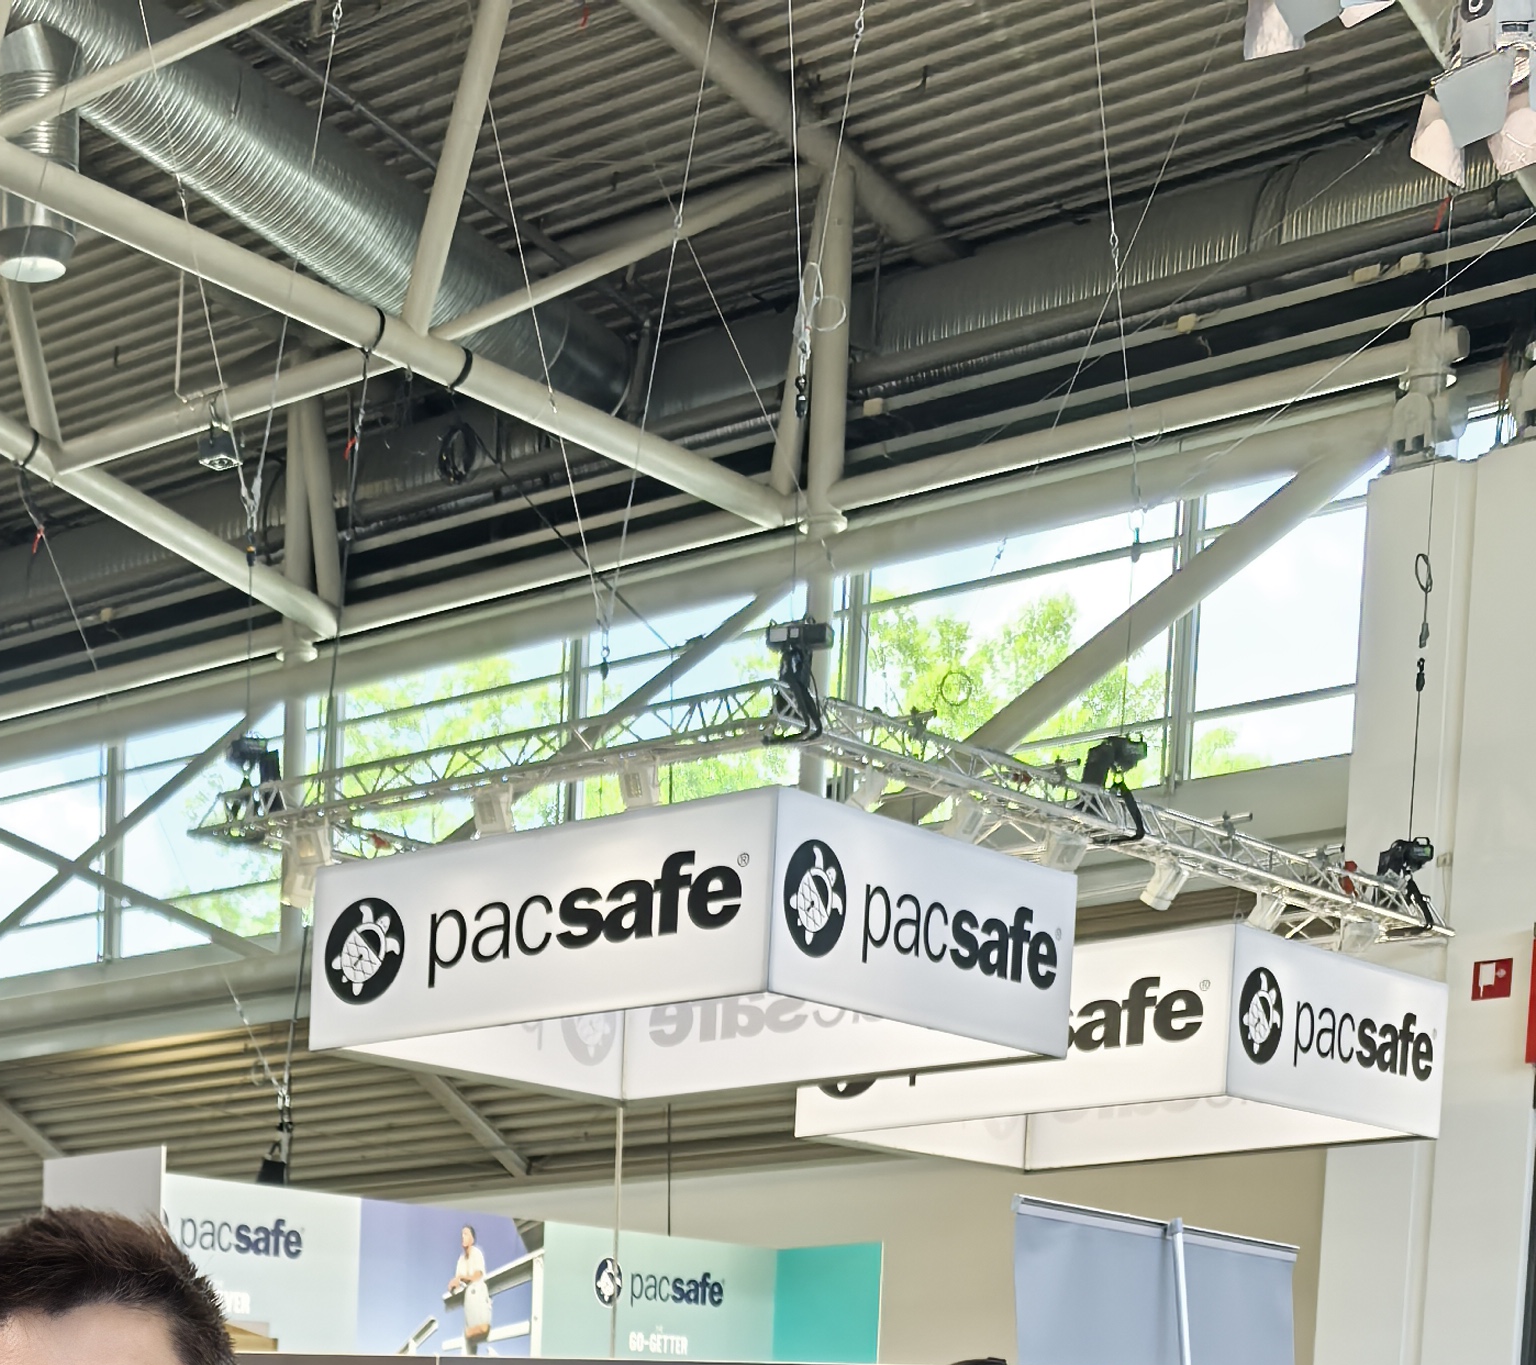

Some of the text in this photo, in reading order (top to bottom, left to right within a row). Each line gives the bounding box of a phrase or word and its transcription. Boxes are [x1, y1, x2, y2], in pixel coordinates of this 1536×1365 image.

[428, 851, 742, 988] pacsafe
[862, 884, 1057, 990] pacsafe
[1294, 996, 1434, 1081] pacsafe
[181, 1218, 302, 1259] pacsafe
[630, 1272, 723, 1308] pacsafe
[629, 1331, 688, 1355] GO-GETTER
